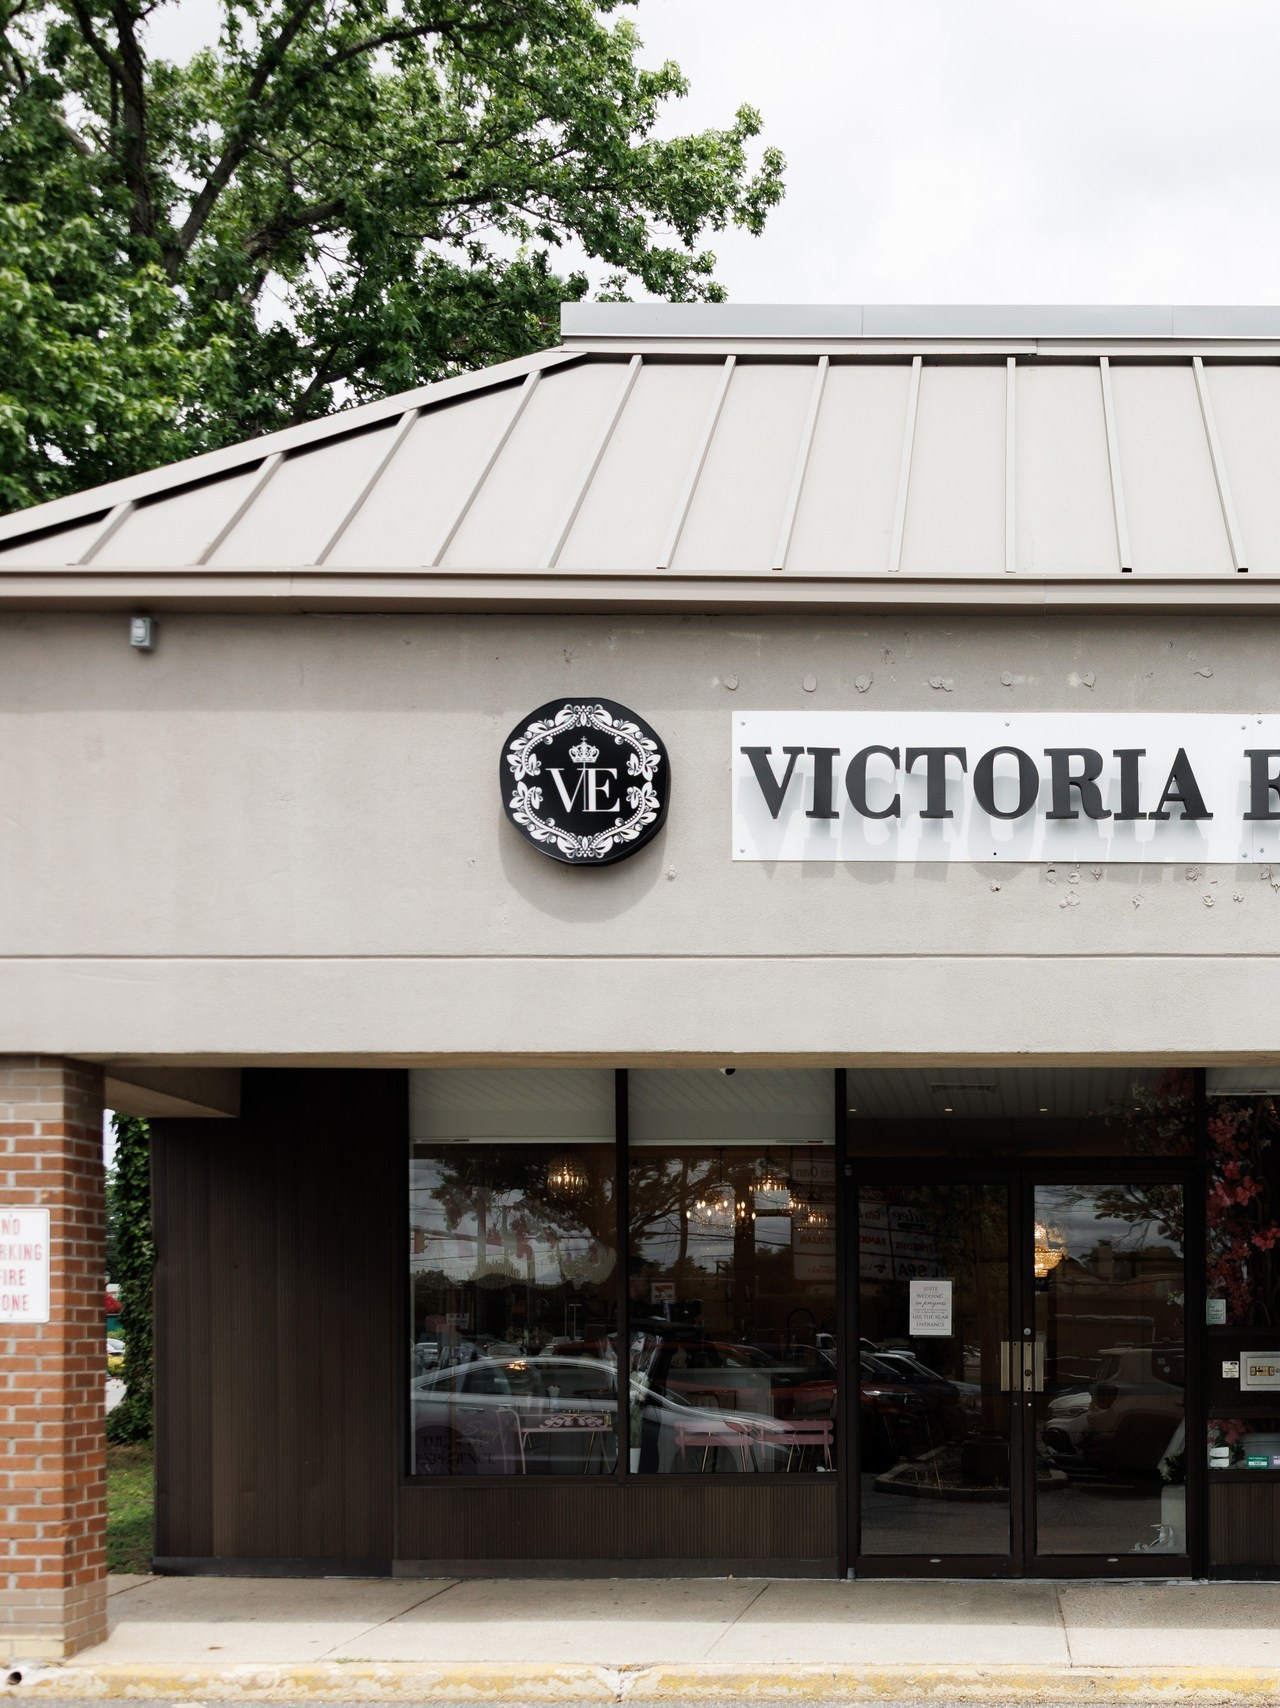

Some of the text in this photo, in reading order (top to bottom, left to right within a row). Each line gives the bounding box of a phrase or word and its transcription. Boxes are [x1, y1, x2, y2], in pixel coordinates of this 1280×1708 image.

[545, 766, 620, 813] VE
[740, 744, 1214, 821] VICTORIA
[2, 1218, 20, 1235] NO
[0, 1244, 42, 1260] RKING
[0, 1269, 26, 1286] IRE
[0, 1294, 29, 1311] ONE
